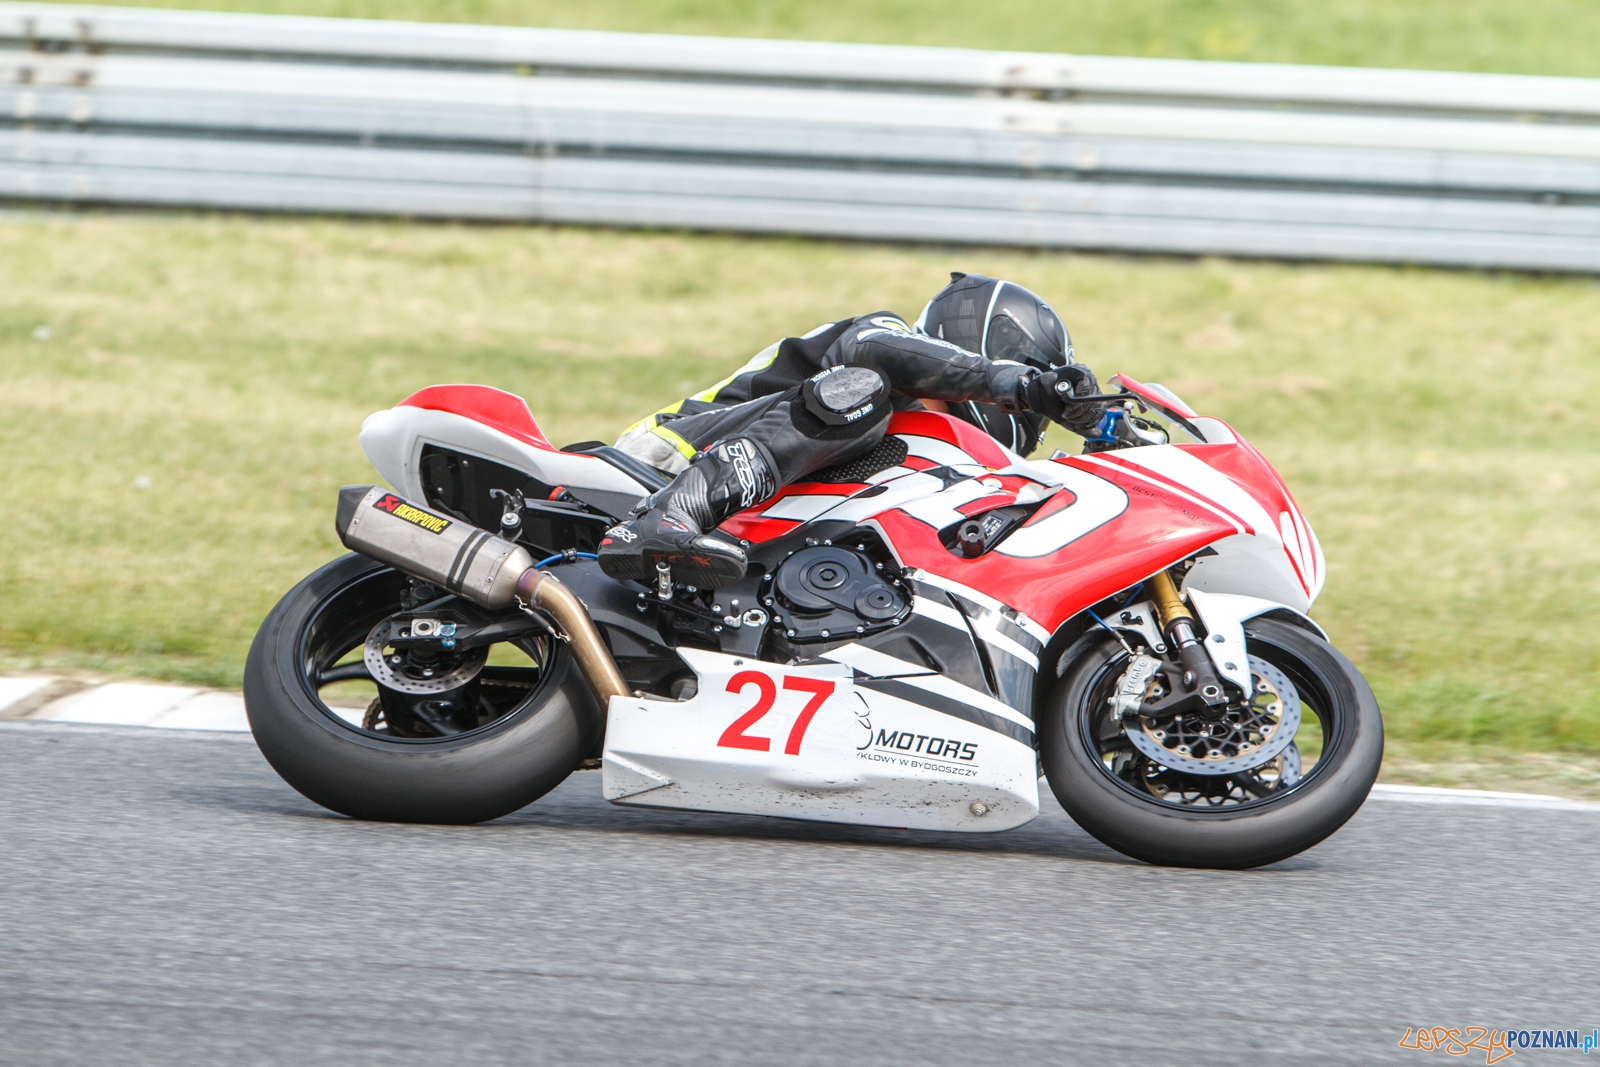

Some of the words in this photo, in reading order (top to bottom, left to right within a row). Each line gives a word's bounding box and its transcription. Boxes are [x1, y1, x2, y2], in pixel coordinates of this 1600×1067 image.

[862, 402, 874, 415] ONE
[1132, 485, 1156, 498] BEST
[1181, 509, 1215, 533] MOTORS
[716, 669, 836, 757] 27
[875, 728, 979, 761] MOTORS
[899, 758, 909, 767] W
[910, 760, 979, 778] BYDGOSZCZY
